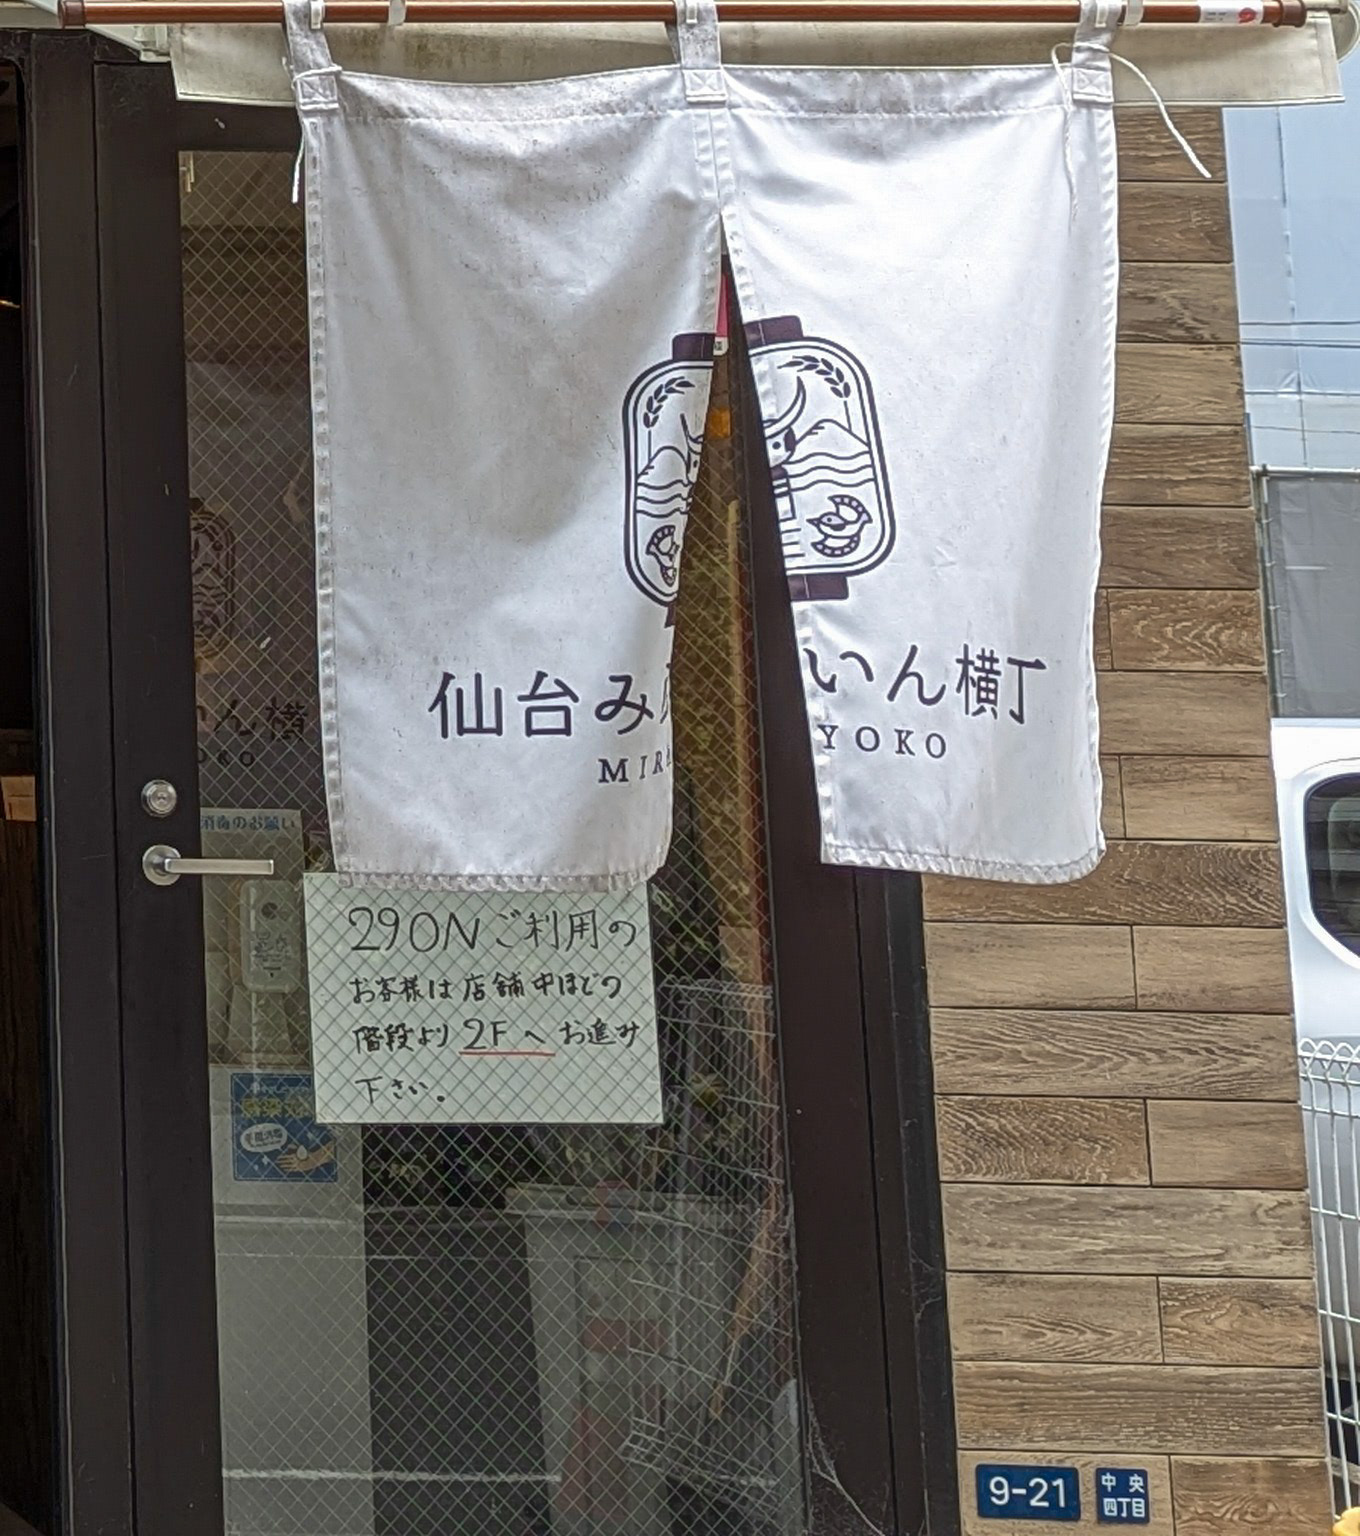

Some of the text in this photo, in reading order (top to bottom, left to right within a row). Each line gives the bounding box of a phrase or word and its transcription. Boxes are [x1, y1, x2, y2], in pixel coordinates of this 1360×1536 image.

[801, 643, 1048, 725] いん横丁
[817, 723, 948, 760] YOKO
[989, 1475, 1066, 1509] 9-21
[1101, 1472, 1146, 1494] 中央
[1102, 1497, 1146, 1518] 四丁目
